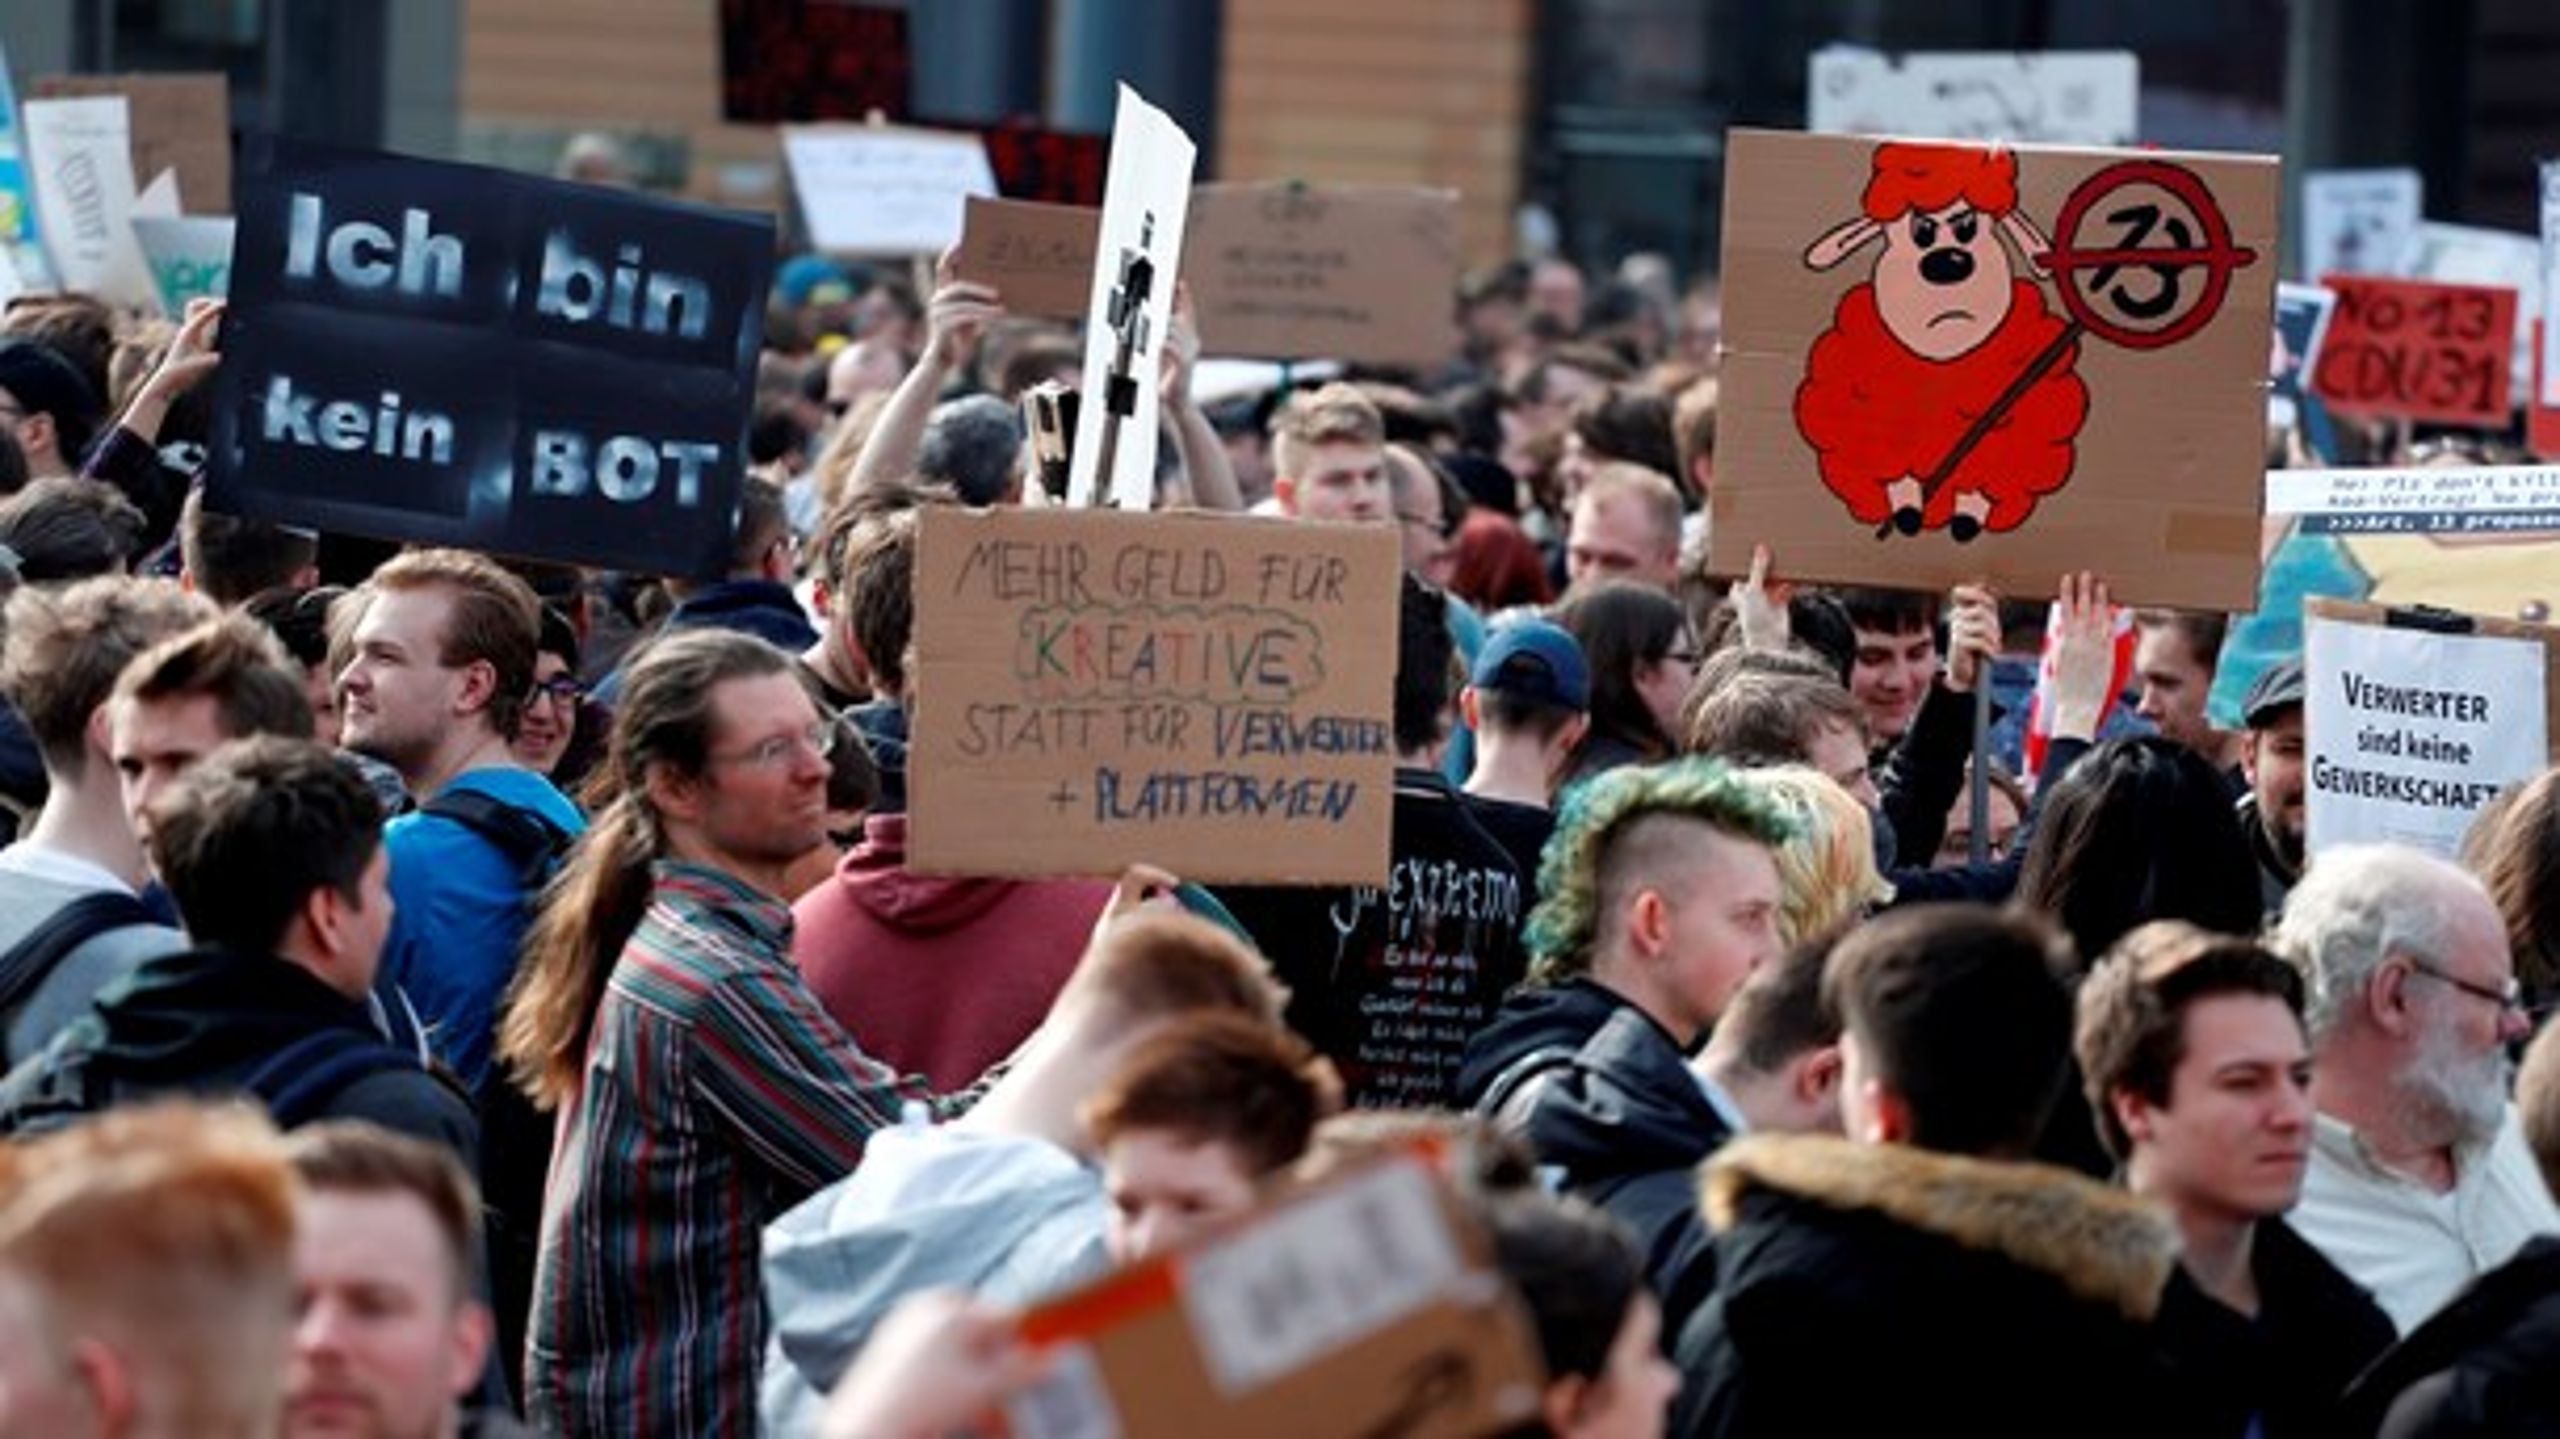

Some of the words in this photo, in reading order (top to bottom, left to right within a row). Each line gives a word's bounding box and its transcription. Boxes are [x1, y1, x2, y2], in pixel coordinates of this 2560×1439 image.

[284, 192, 463, 297] Ich
[536, 226, 713, 340] bin
[2417, 291, 2495, 343] 13
[262, 374, 456, 465] kein
[531, 428, 721, 506] BOT
[954, 540, 1094, 603] MEHR
[1112, 543, 1227, 598] GELD
[1259, 553, 1350, 604] FÜR
[1034, 618, 1296, 686] KREATIVE
[2341, 671, 2489, 723] VERWERTER
[955, 703, 1099, 756] STATT
[1121, 704, 1193, 751] FÜR
[2357, 725, 2401, 756] sind
[2407, 730, 2473, 765] keine
